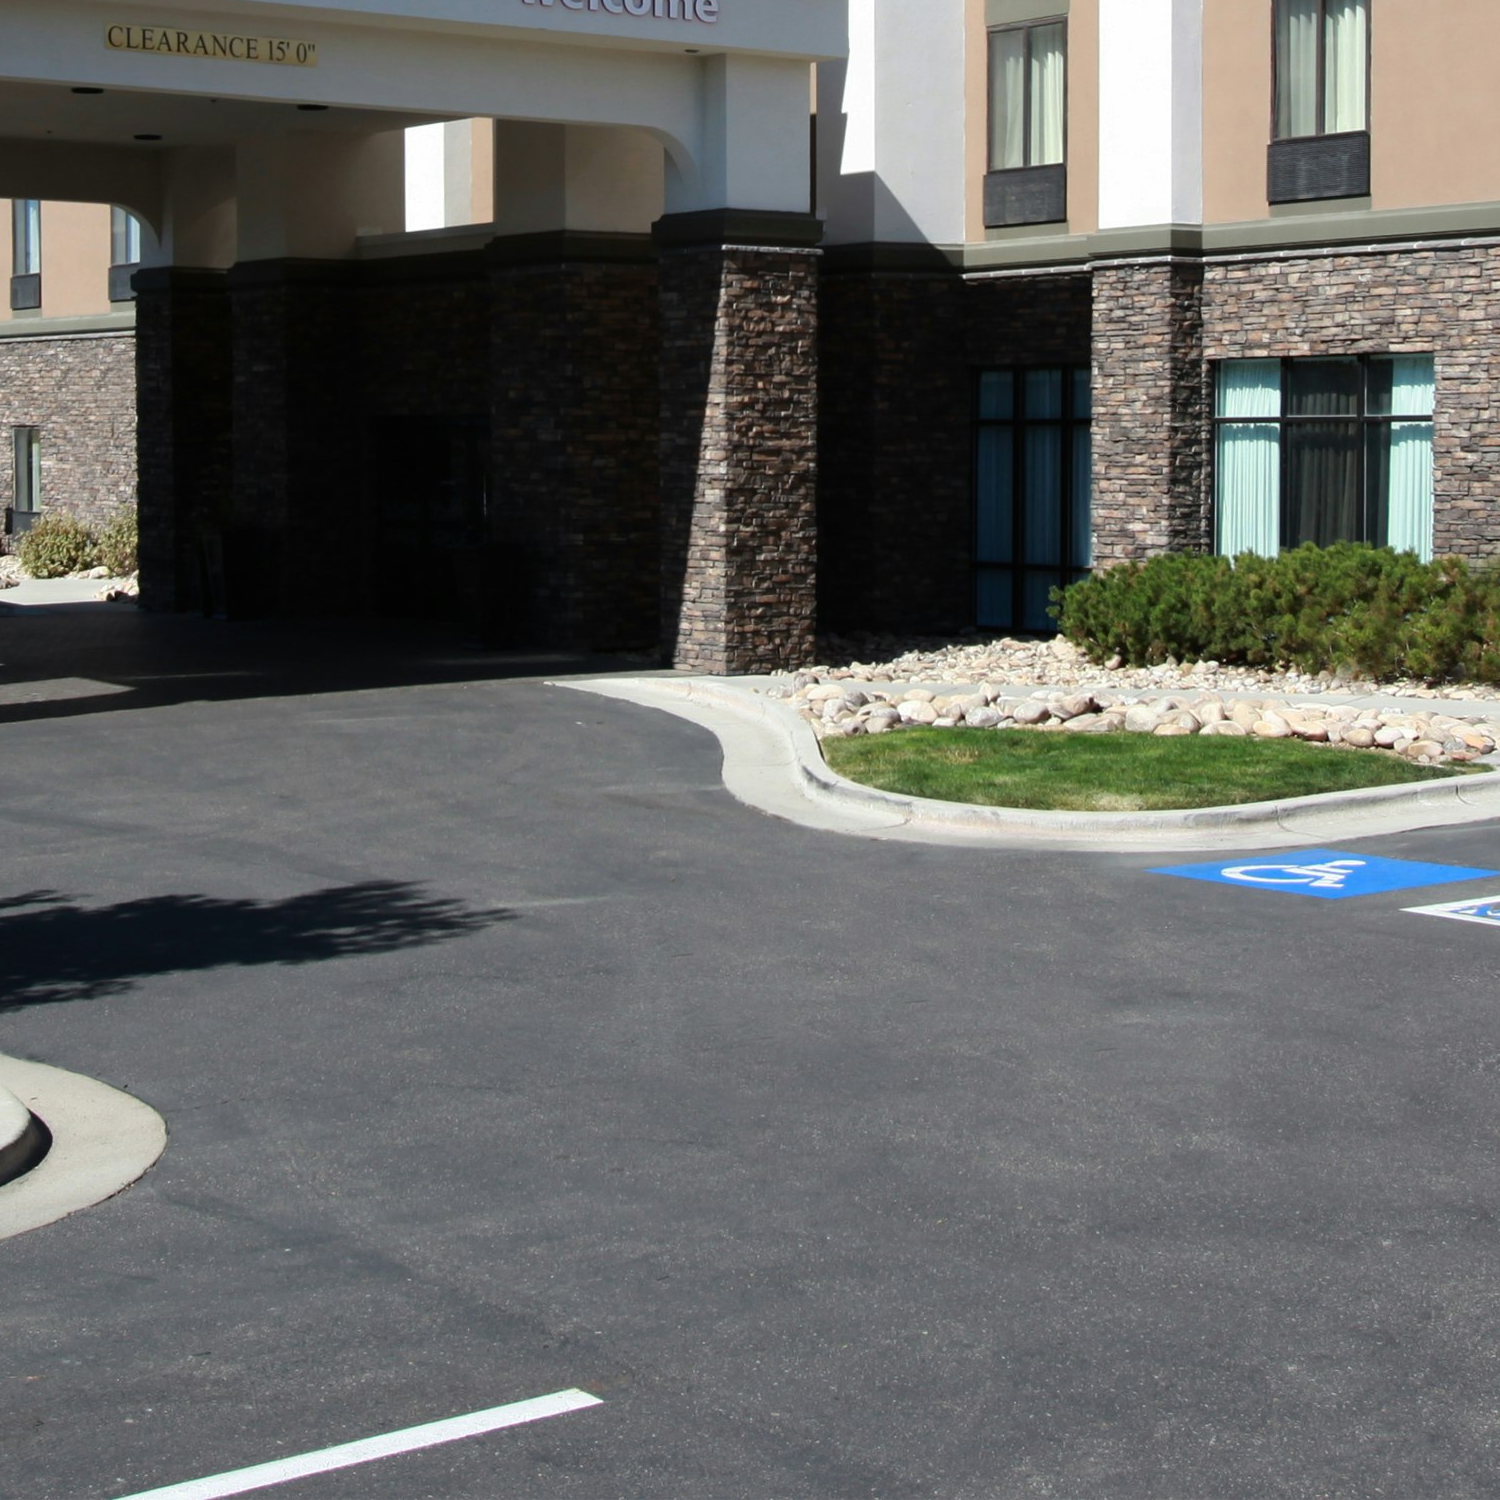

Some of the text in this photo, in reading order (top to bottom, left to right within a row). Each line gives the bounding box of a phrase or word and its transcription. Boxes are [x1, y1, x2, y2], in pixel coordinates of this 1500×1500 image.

[107, 25, 316, 64] CLEARANCE 15' 0"
